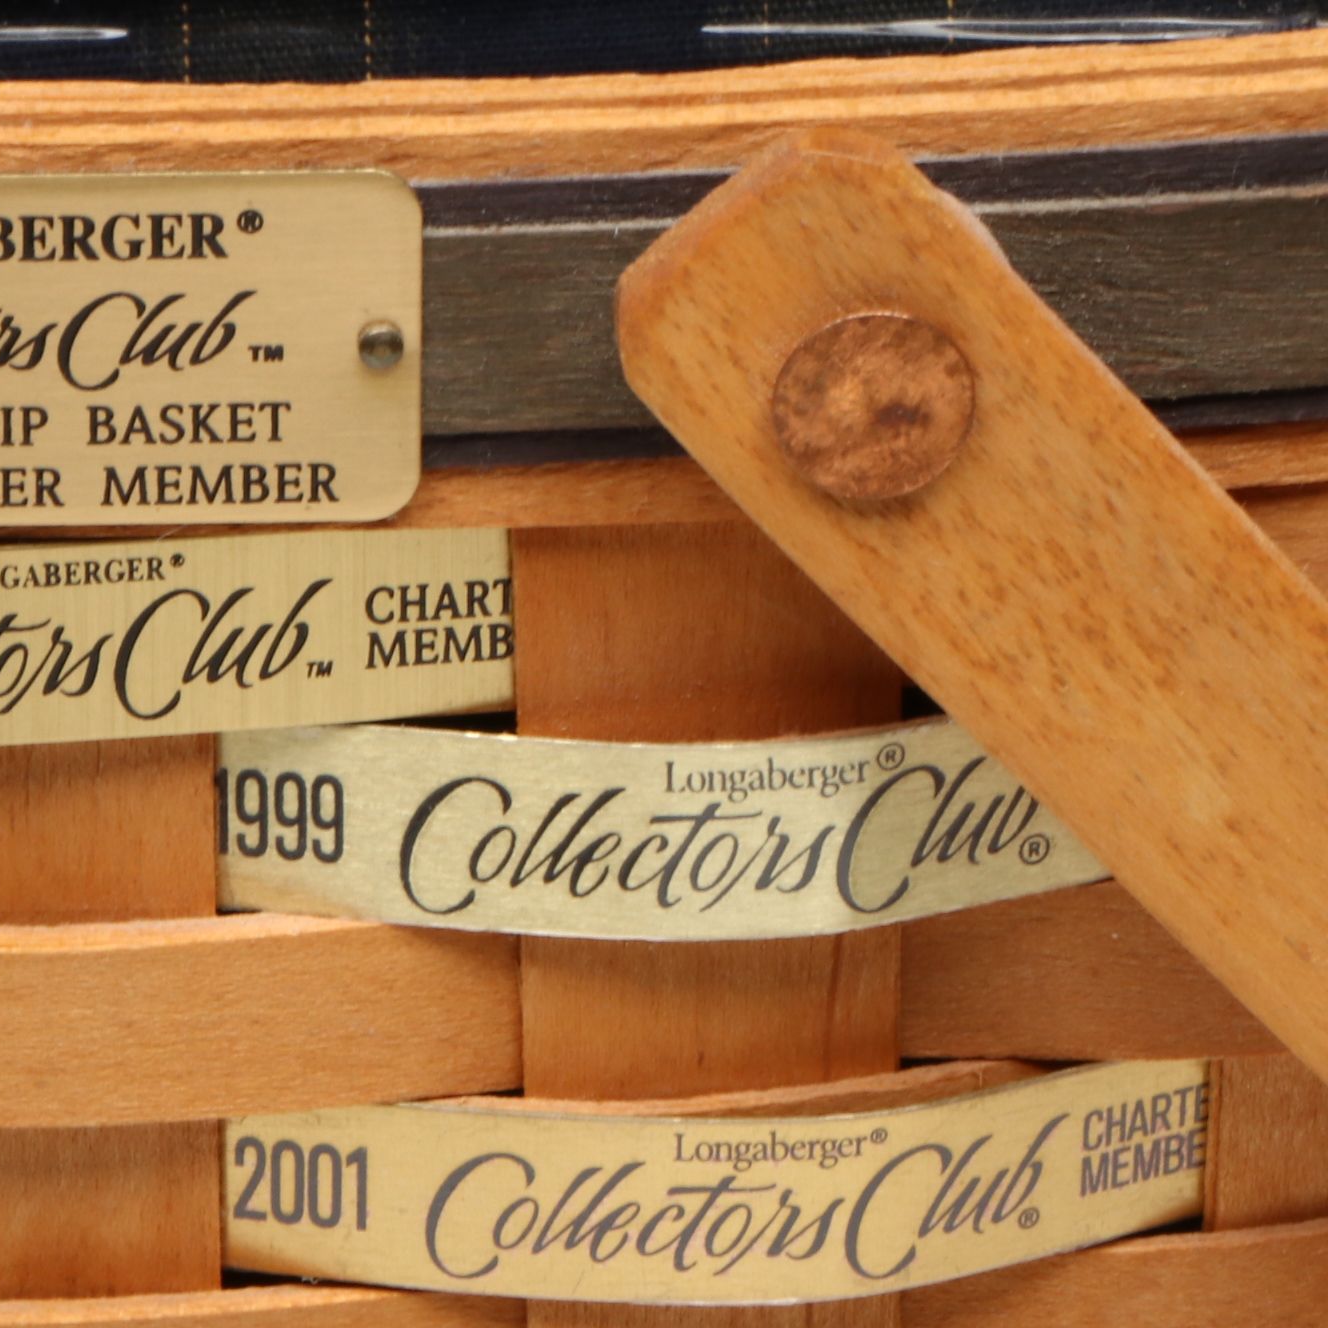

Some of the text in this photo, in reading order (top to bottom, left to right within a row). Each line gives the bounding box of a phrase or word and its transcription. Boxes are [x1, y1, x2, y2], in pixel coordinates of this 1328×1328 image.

[87, 401, 292, 446] BASKET
[100, 463, 339, 507] MEMBER
[216, 767, 344, 863] 1999
[399, 776, 836, 914] Collectors
[233, 1137, 369, 1231] 2001
[424, 1153, 844, 1278] Collectors
